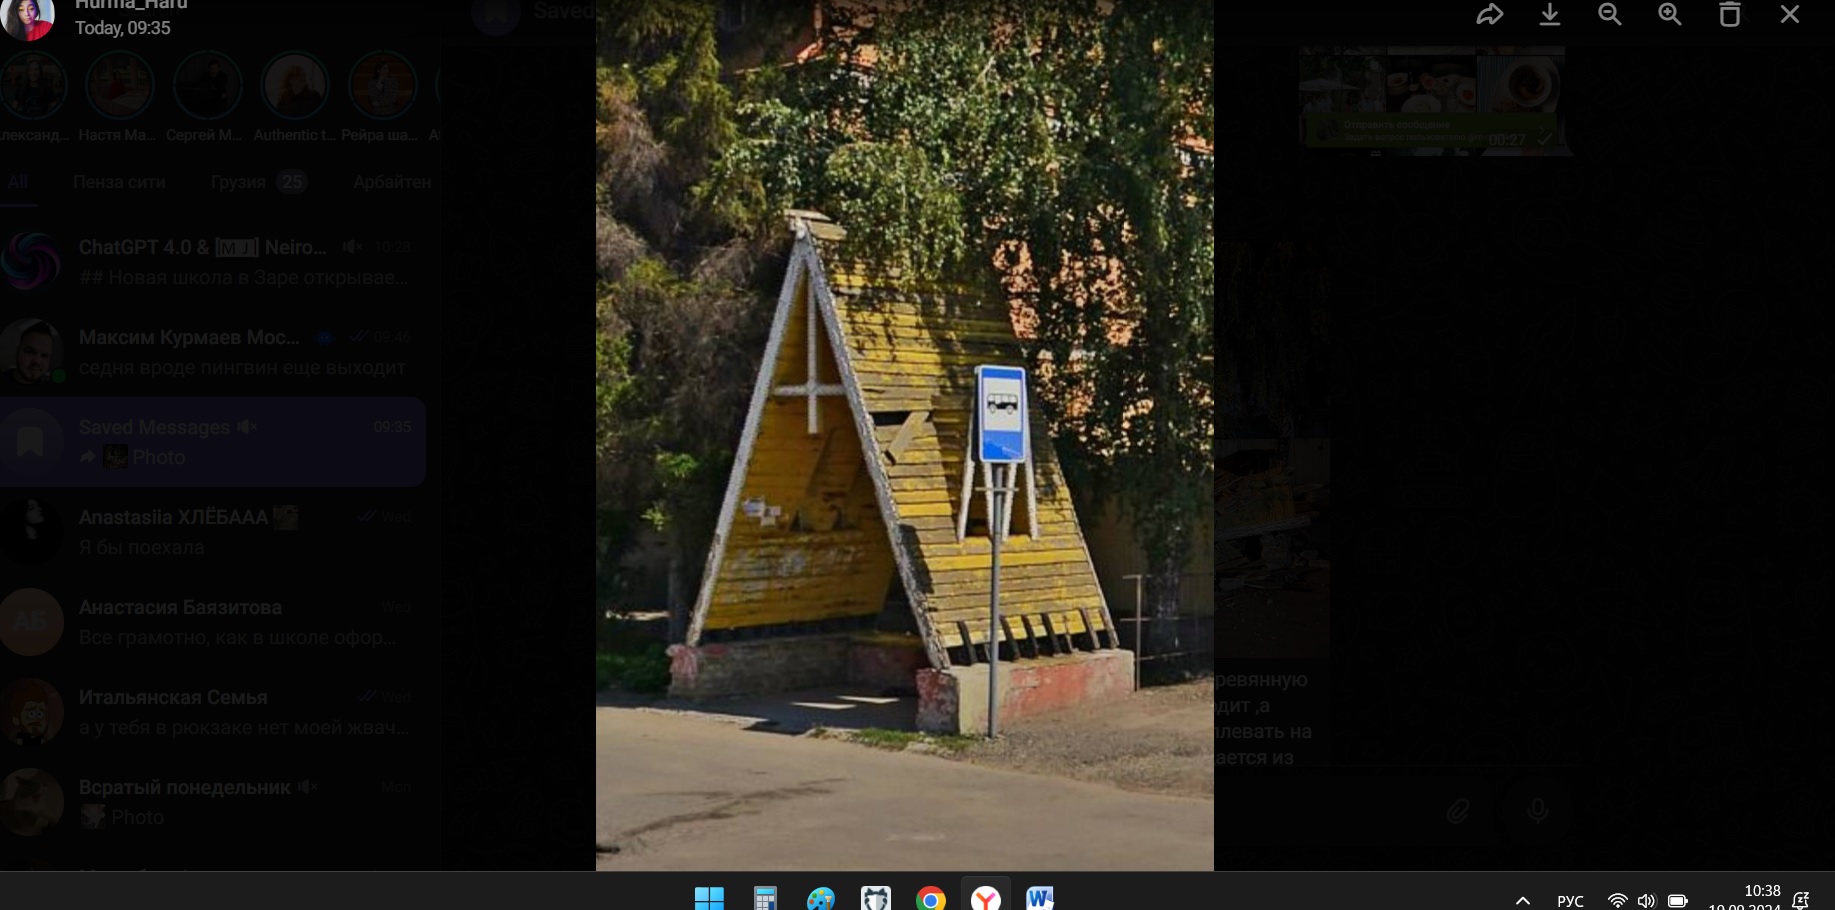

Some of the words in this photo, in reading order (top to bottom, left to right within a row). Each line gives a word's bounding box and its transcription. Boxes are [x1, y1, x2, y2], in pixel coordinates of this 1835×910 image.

[534, 1, 594, 19] Saved
[75, 20, 124, 38] Today,
[128, 21, 170, 35] 09:35
[0, 132, 69, 143] лександ...
[79, 129, 120, 140] Настя
[167, 129, 215, 143] Сергей
[254, 128, 318, 140] Authentic
[342, 129, 384, 143] Рейра
[8, 174, 28, 188] All
[74, 175, 123, 188] Пенза
[128, 178, 165, 188] сити
[212, 175, 265, 192] Грузия
[283, 175, 302, 189] 25
[354, 174, 431, 192] Арбайтен
[79, 239, 159, 255] ChatGPT
[163, 239, 191, 254] 4.0
[197, 239, 209, 255] &
[110, 269, 166, 284] Новая
[173, 273, 232, 284] школа
[239, 272, 249, 285] в
[255, 269, 298, 288] Заре
[80, 329, 154, 344] Максим
[161, 329, 241, 348] Курмаев
[80, 363, 133, 378] седня
[140, 363, 195, 378] вроде
[202, 363, 277, 374] пингвин
[283, 363, 320, 377] еще
[326, 363, 406, 378] выходит
[79, 419, 133, 435] Saved
[139, 419, 231, 438] Messages
[374, 421, 411, 433] 09:35
[133, 449, 186, 465] Photo
[79, 509, 172, 525] Anastasiia
[382, 511, 410, 523] Wed
[80, 539, 90, 554] Я
[97, 539, 122, 554] бы
[129, 543, 204, 555] поехала
[79, 600, 177, 614] Анастасия
[184, 600, 282, 615] Баязитова
[382, 600, 410, 613] Wed
[80, 630, 112, 644] Все
[119, 633, 210, 648] грамотно,
[216, 633, 247, 644] как
[254, 633, 263, 644] в
[270, 633, 329, 645] школе
[80, 689, 201, 704] Итальянская
[208, 689, 267, 704] Семья
[382, 690, 410, 703] Wed
[80, 723, 89, 734] а
[93, 723, 103, 739] у
[109, 719, 149, 734] тебя
[157, 723, 166, 734] в
[173, 723, 252, 739] рюкзаке
[259, 723, 289, 735] нет
[295, 719, 341, 735] моей
[1291, 727, 1312, 738] на
[1214, 752, 1267, 766] ается
[1273, 752, 1295, 765] из
[80, 779, 160, 798] Всратый
[167, 783, 291, 798] понедельник
[382, 781, 411, 792] Mon
[113, 809, 164, 824] Photo
[1746, 885, 1781, 896] 10:38
[1558, 896, 1583, 907] РУС
